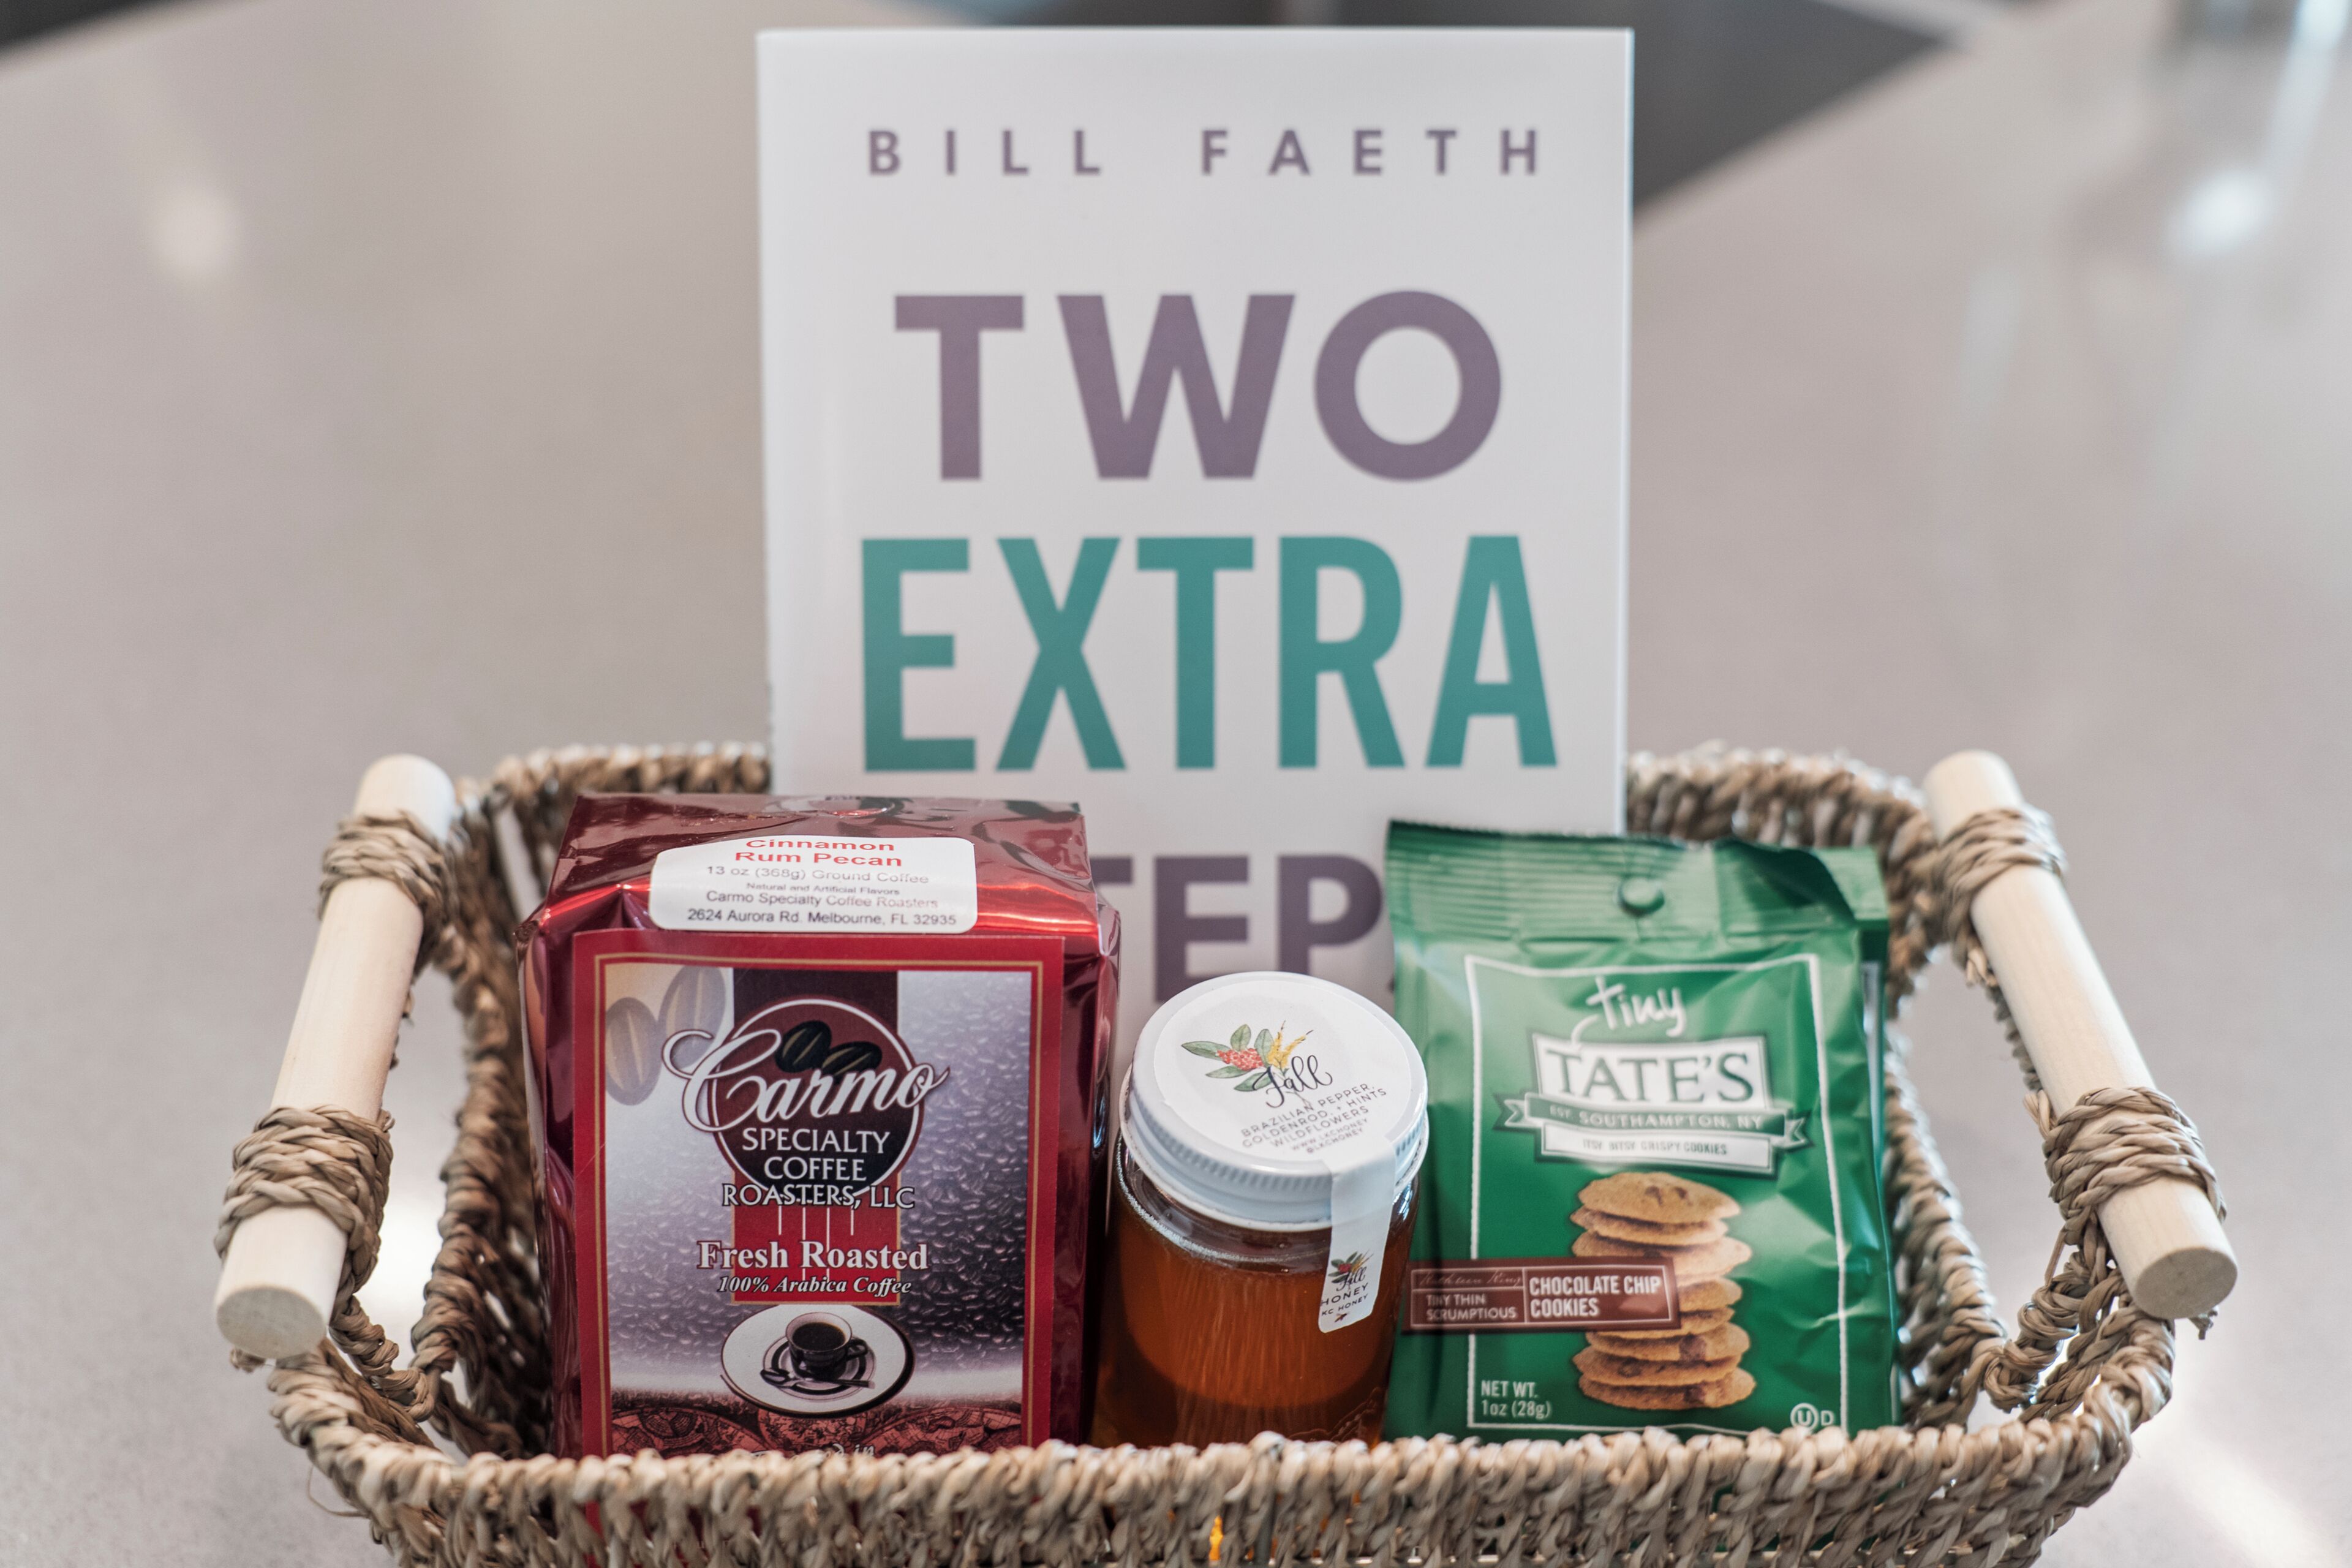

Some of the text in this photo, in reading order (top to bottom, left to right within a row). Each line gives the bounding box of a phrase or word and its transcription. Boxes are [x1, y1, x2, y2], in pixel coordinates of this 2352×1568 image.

[869, 129, 1539, 176] BILL FAETH
[894, 289, 1502, 483] TWO
[861, 535, 1558, 772] EXTRA
[746, 839, 894, 851] Cinnamon
[736, 852, 902, 867] Rum Pecan
[707, 866, 725, 875] 13
[812, 870, 870, 881] Ground
[877, 872, 929, 883] Coffee
[706, 891, 938, 908] Carmo Specialty Coffee Roasters
[813, 885, 856, 894] Artificial
[687, 908, 722, 922] 2624
[727, 910, 774, 922] Aurora
[808, 911, 886, 925] Melbourne,
[891, 914, 908, 925] FL
[913, 914, 957, 925] 32935
[1585, 976, 1687, 1037] tiny
[662, 1027, 951, 1133] Carmo
[1545, 1049, 1755, 1104] TATE'S
[1346, 1088, 1387, 1107] HINTS
[1241, 1104, 1314, 1137] BRAZILIAN
[1270, 1106, 1369, 1147] WILDFLOWERS
[1738, 1115, 1764, 1129] NY
[742, 1127, 890, 1153] SPECIALTY
[1641, 1140, 1681, 1152] CRISPY
[1684, 1142, 1728, 1155] COOKIES
[764, 1156, 867, 1181] COFFEE
[723, 1183, 915, 1209] ROASTERS, LLC
[697, 1240, 929, 1270] Fresh Roasted
[718, 1276, 912, 1298] 100% Arabica Coffee
[1321, 1282, 1368, 1306] HONEY
[1529, 1275, 1662, 1296] CHOCOLATE CHIP
[1338, 1294, 1368, 1311] HONEY
[1426, 1294, 1487, 1307] TINY THIN
[1530, 1297, 1600, 1318] COOKIES
[1426, 1306, 1517, 1321] SCRUMPTIOUS
[1481, 1380, 1539, 1398] NET WT.
[1482, 1399, 1552, 1420] 1oz (28g)
